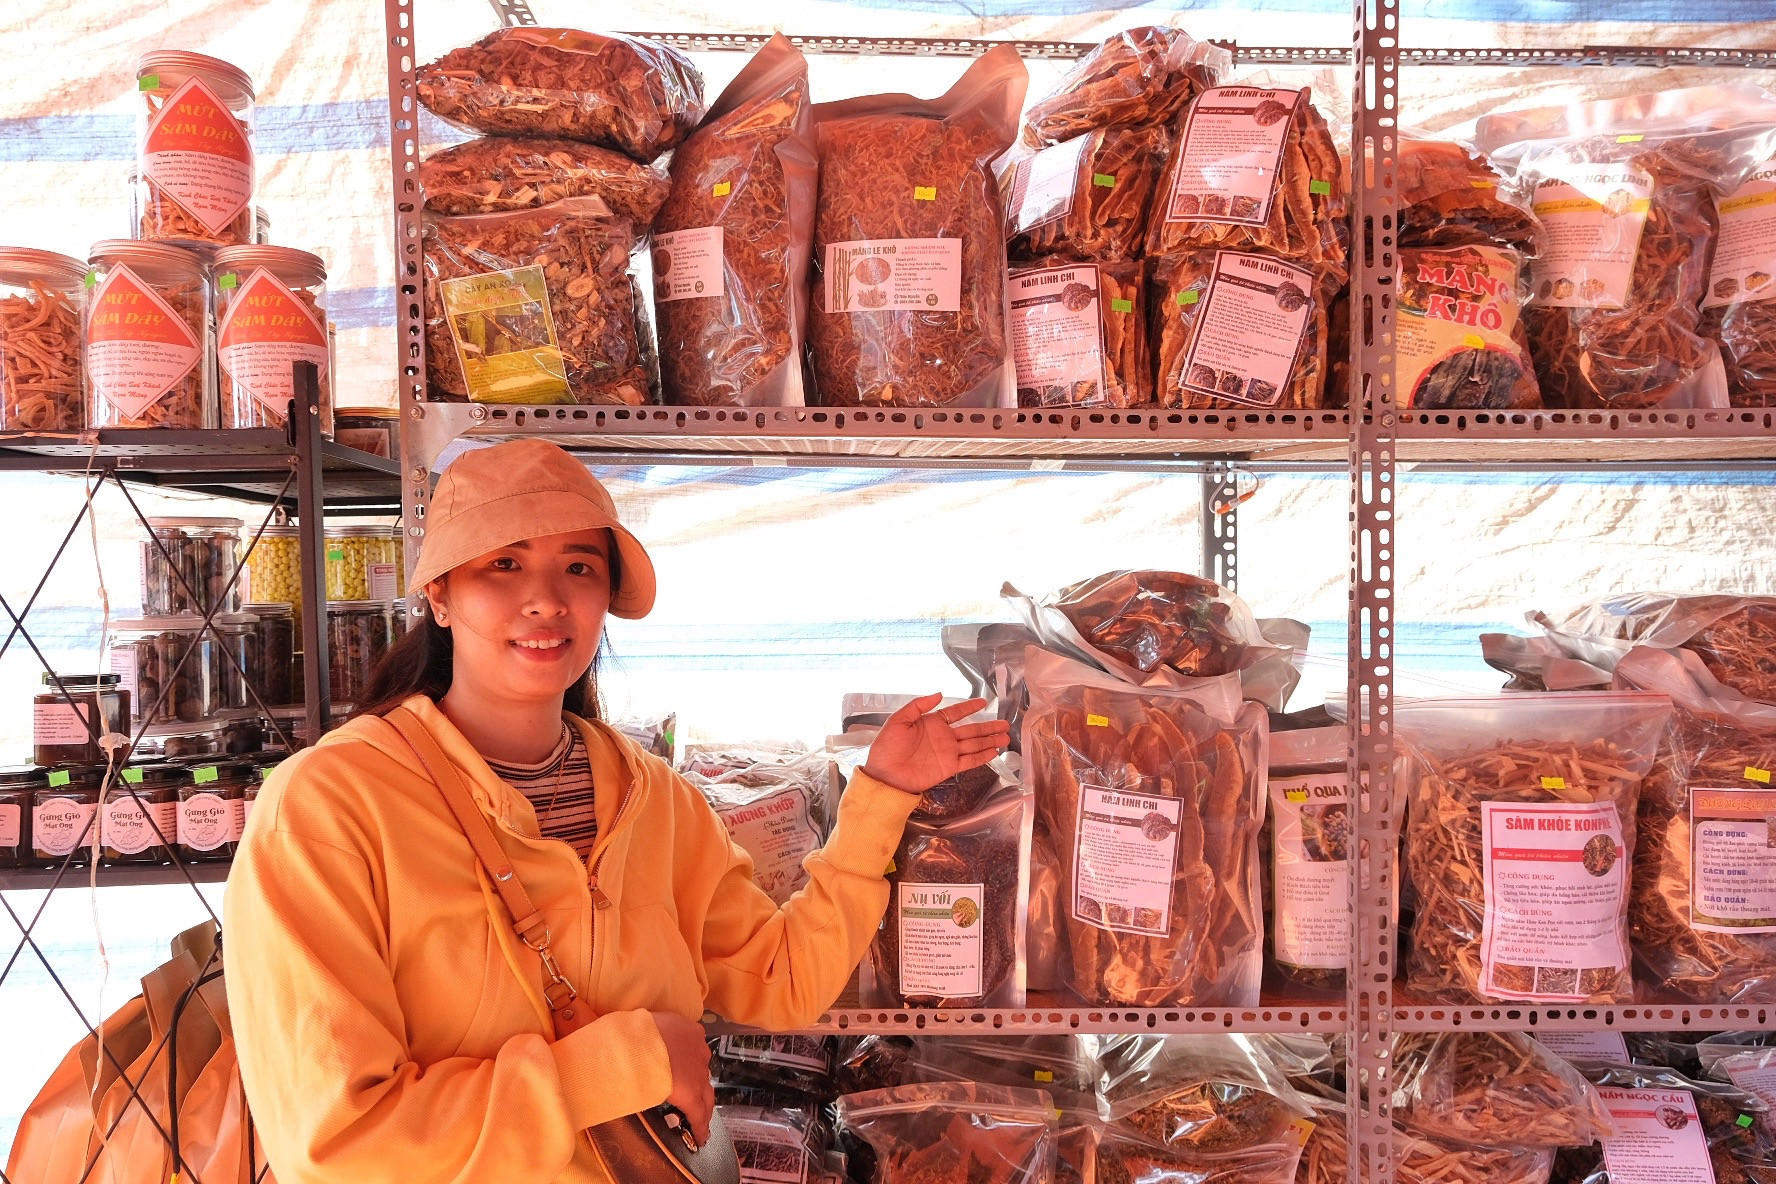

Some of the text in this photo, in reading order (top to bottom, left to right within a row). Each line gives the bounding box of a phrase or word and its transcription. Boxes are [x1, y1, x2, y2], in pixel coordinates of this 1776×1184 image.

[160, 121, 197, 135] SÂM
[873, 246, 881, 255] LE
[882, 244, 897, 254] KHÔ
[1040, 274, 1059, 285] LINH
[1060, 271, 1075, 282] CHI
[1259, 262, 1280, 275] LINH
[1280, 268, 1294, 280] CHI
[484, 281, 497, 291] AN
[1416, 263, 1509, 304] MĂNG
[124, 311, 165, 326] DÂY
[1424, 293, 1502, 331] KHÔ
[271, 313, 307, 328] DÂY
[1313, 785, 1342, 798] QUA
[1121, 797, 1142, 809] LINH
[1142, 800, 1158, 811] CHI
[729, 797, 796, 827] XƯƠNG KHỚP
[129, 820, 144, 828] Ong
[203, 817, 218, 825] Ong
[1505, 815, 1535, 830] SÂM
[1537, 815, 1572, 831] KHỎE
[1702, 829, 1724, 837] CÔNG
[1507, 872, 1530, 880] CÔNG
[1599, 1090, 1659, 1102] NẤM NGỌC
